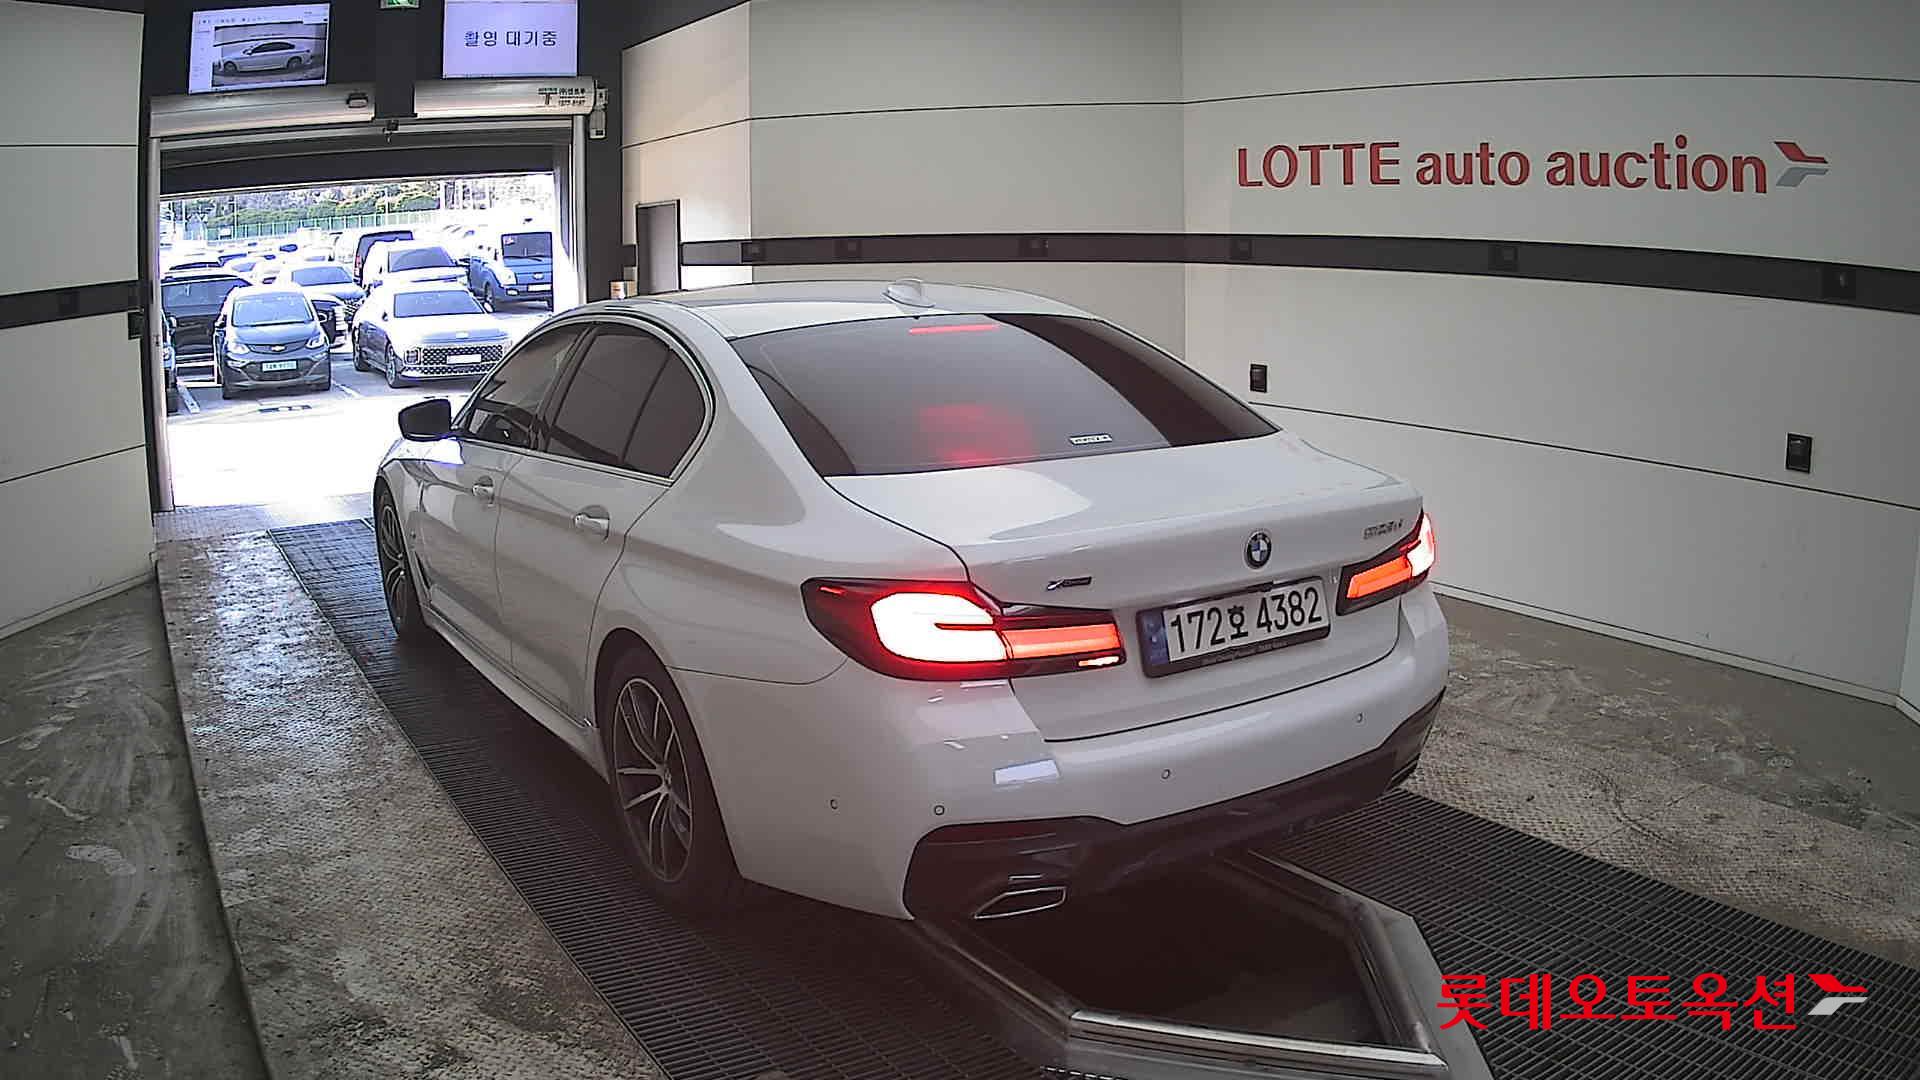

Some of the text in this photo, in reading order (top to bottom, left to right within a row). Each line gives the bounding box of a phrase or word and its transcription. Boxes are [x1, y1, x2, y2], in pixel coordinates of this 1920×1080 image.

[464, 31, 557, 47] 촬영 대기중
[1236, 134, 1767, 194] LOTTE auto auction
[1171, 605, 1249, 652] 172호
[1257, 586, 1322, 632] 4382
